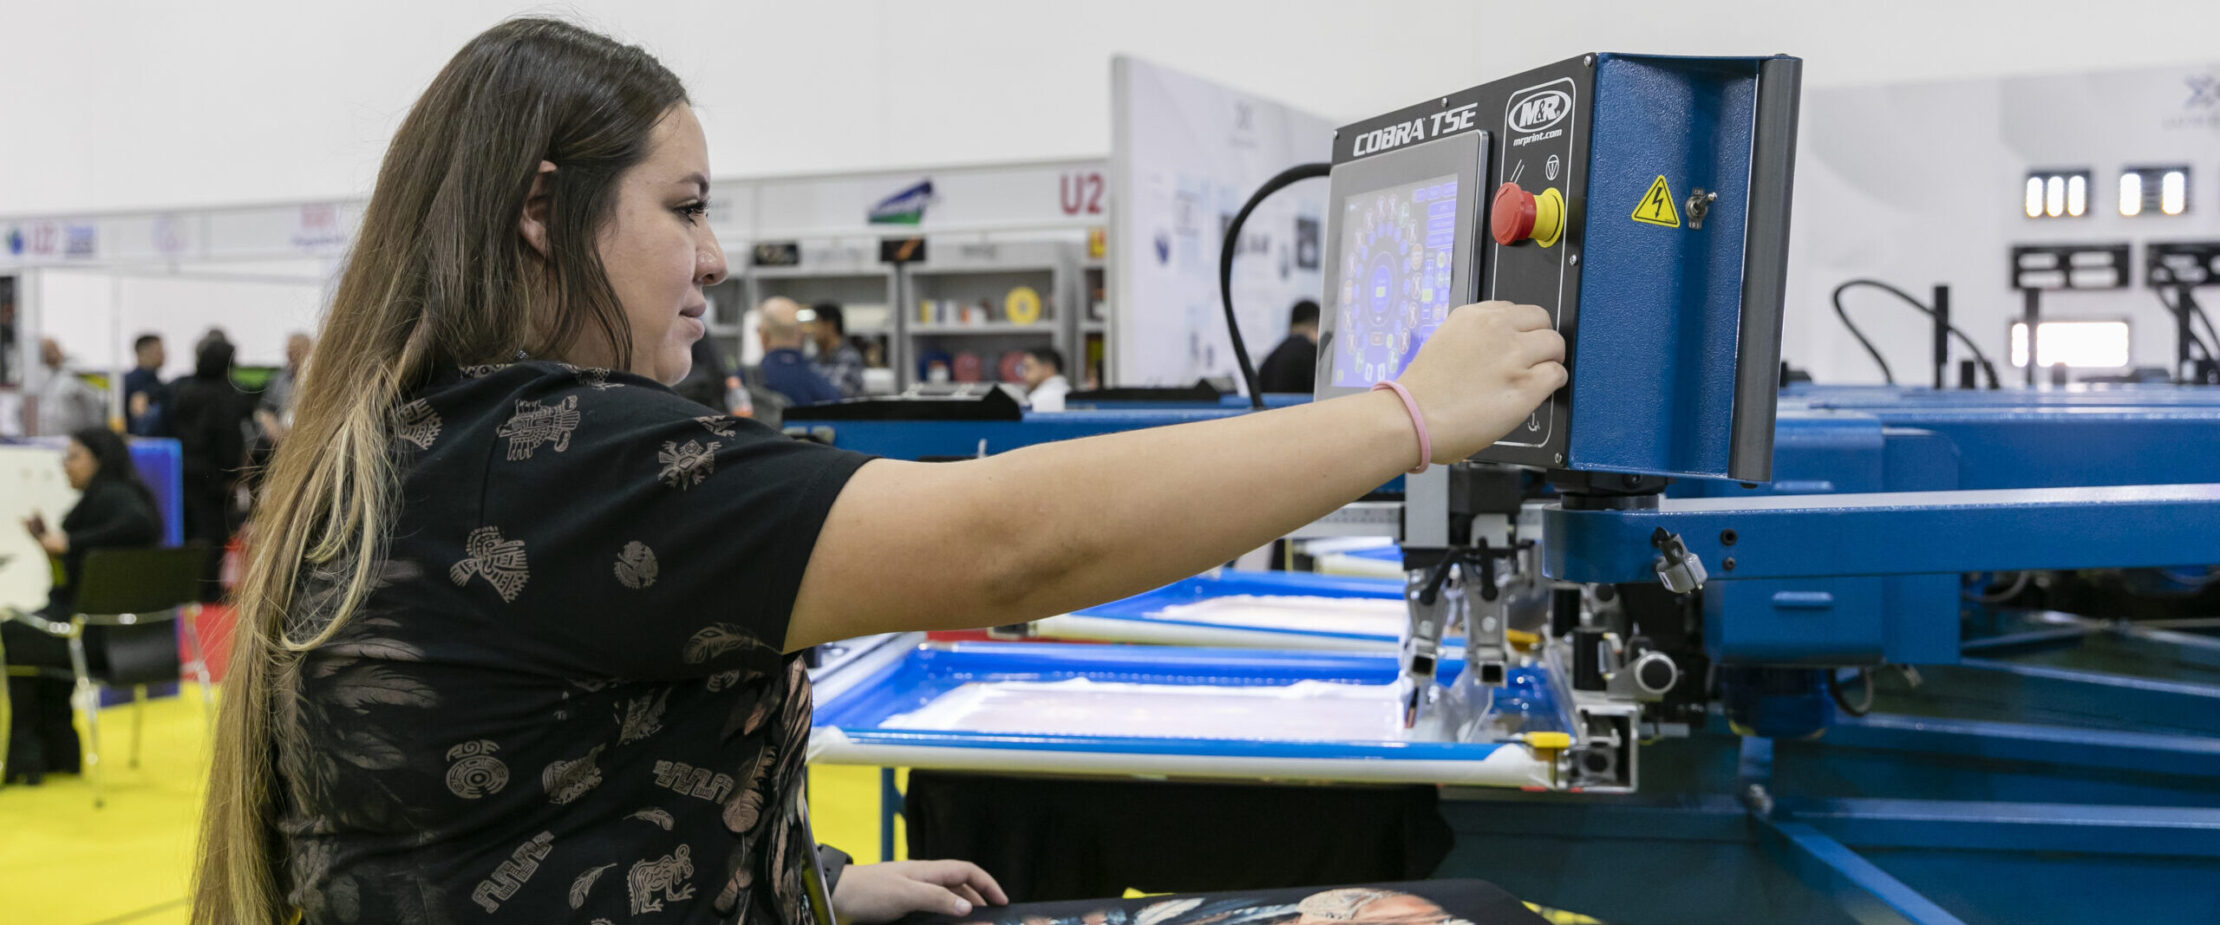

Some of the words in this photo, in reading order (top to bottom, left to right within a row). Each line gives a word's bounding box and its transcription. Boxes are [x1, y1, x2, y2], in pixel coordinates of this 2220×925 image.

[1353, 118, 1425, 157] COBRA
[1430, 102, 1478, 137] TSE
[1513, 129, 1562, 146] mrprint.com
[1060, 173, 1104, 215] U2
